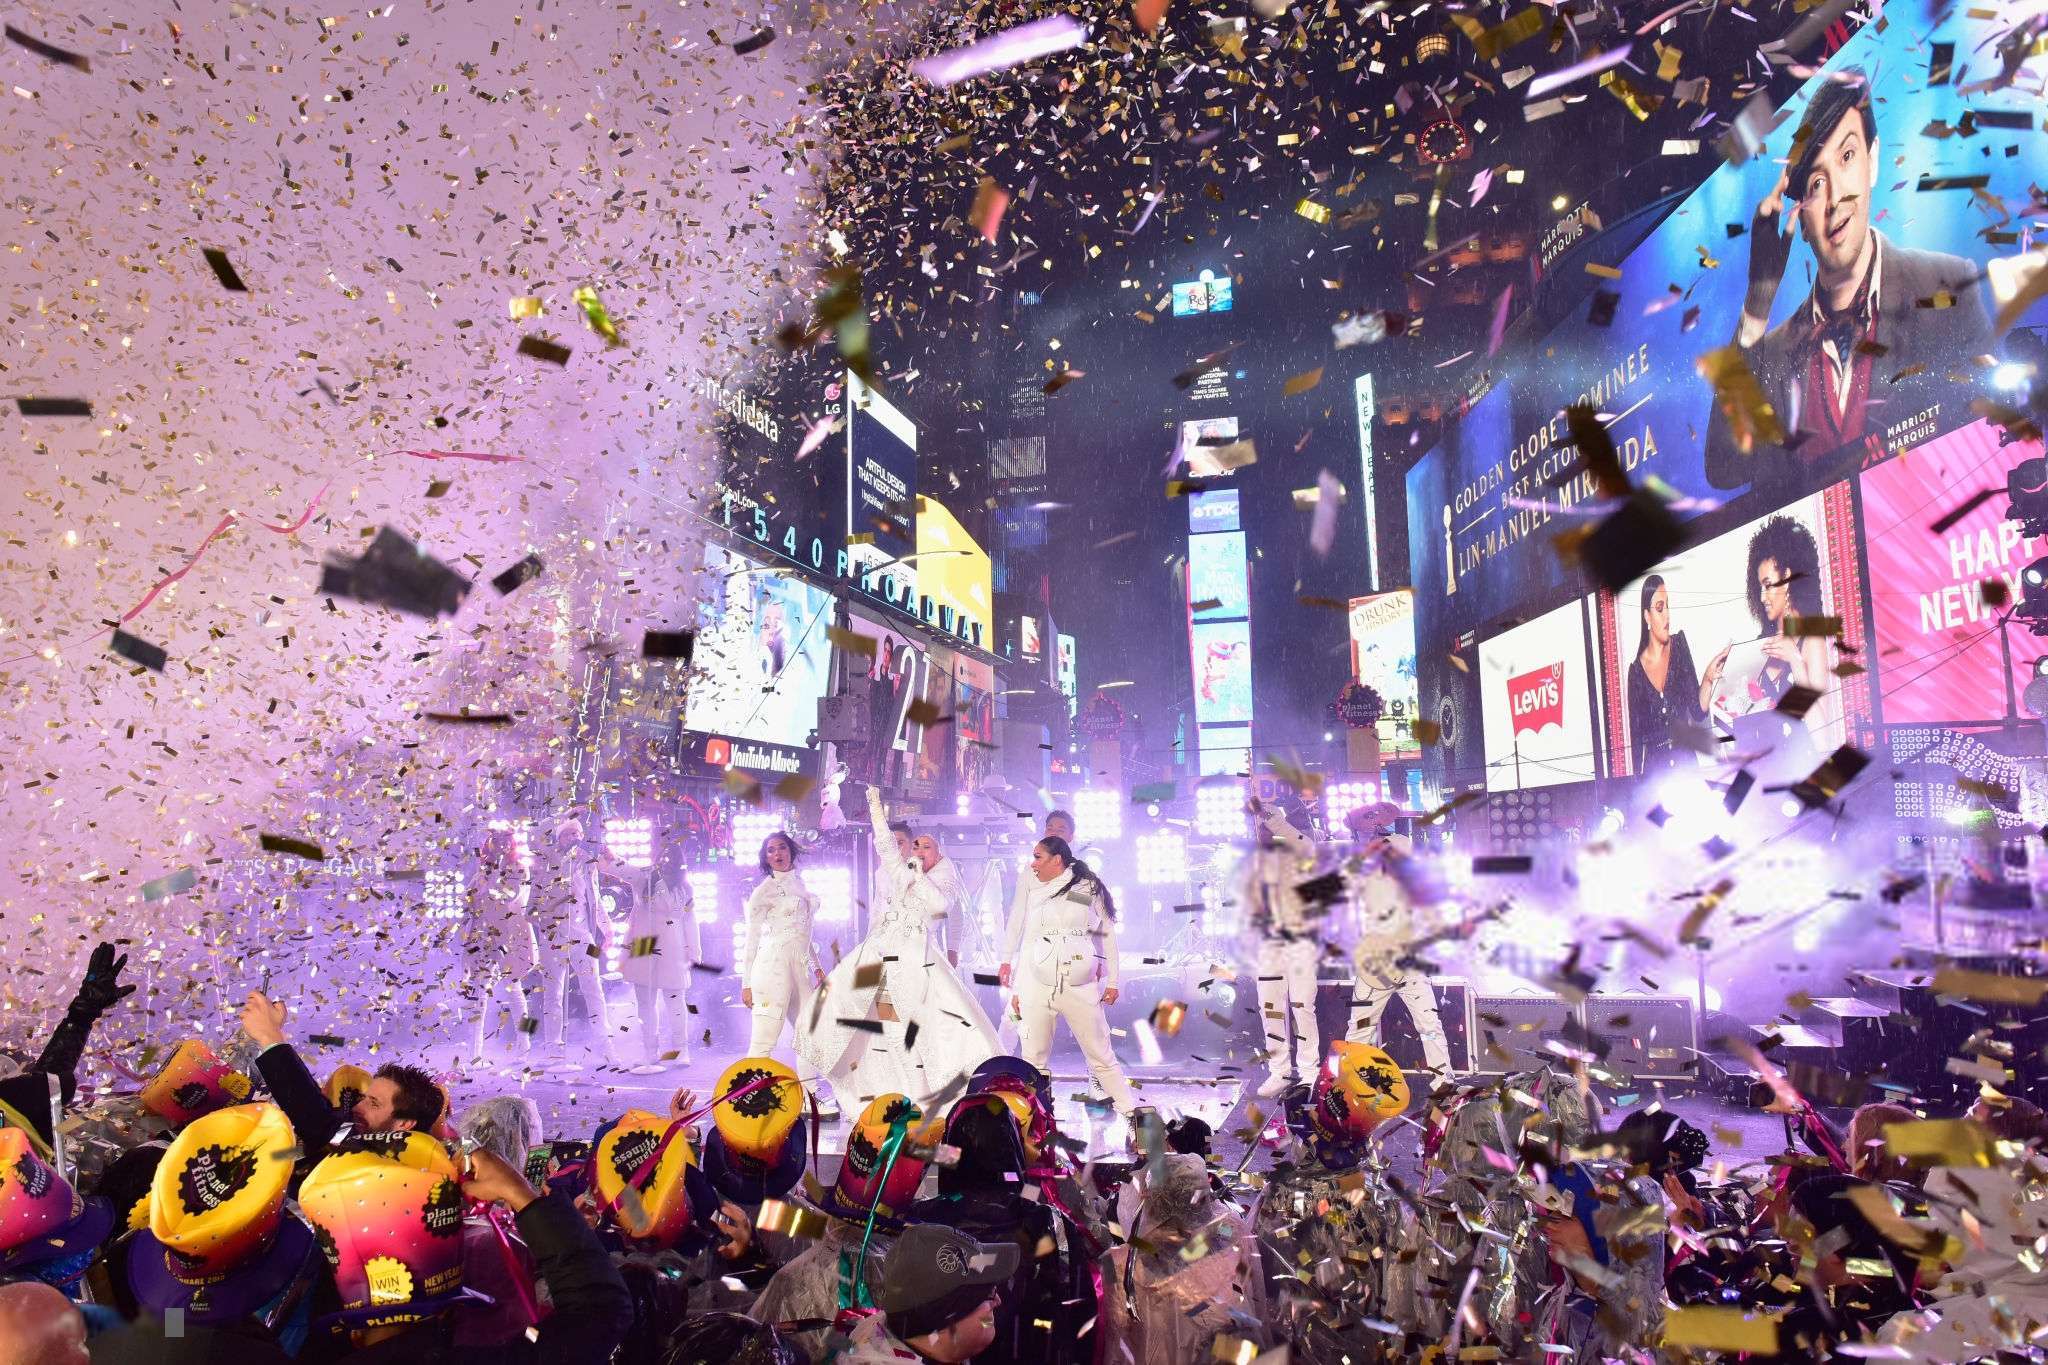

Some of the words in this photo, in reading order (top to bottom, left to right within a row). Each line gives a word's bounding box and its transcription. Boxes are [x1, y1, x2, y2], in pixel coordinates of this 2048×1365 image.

[1541, 201, 1589, 252] MARROTT
[1542, 224, 1583, 269] MARQUIS
[825, 404, 841, 415] LG
[1887, 403, 1941, 438] MARRIOTT
[1455, 461, 1505, 514] GOLDEN
[1509, 417, 1558, 473] GLOBE
[1566, 343, 1650, 432] OMINEE
[1888, 422, 1937, 452] MARQUIS
[857, 465, 874, 486] THAT
[865, 456, 888, 482] ARTFUL
[1501, 475, 1530, 511] BEST
[722, 492, 823, 568] 1540
[1459, 496, 1551, 577] LIN-MANUEL
[1354, 596, 1407, 627] DRUNK
[730, 743, 771, 770] YouTube
[770, 750, 800, 774] Music
[191, 1166, 221, 1208] fitness
[197, 1153, 231, 1195] planet
[375, 1275, 400, 1289] WIN
[424, 1271, 444, 1289] NEW
[366, 1314, 422, 1327] PLANET
